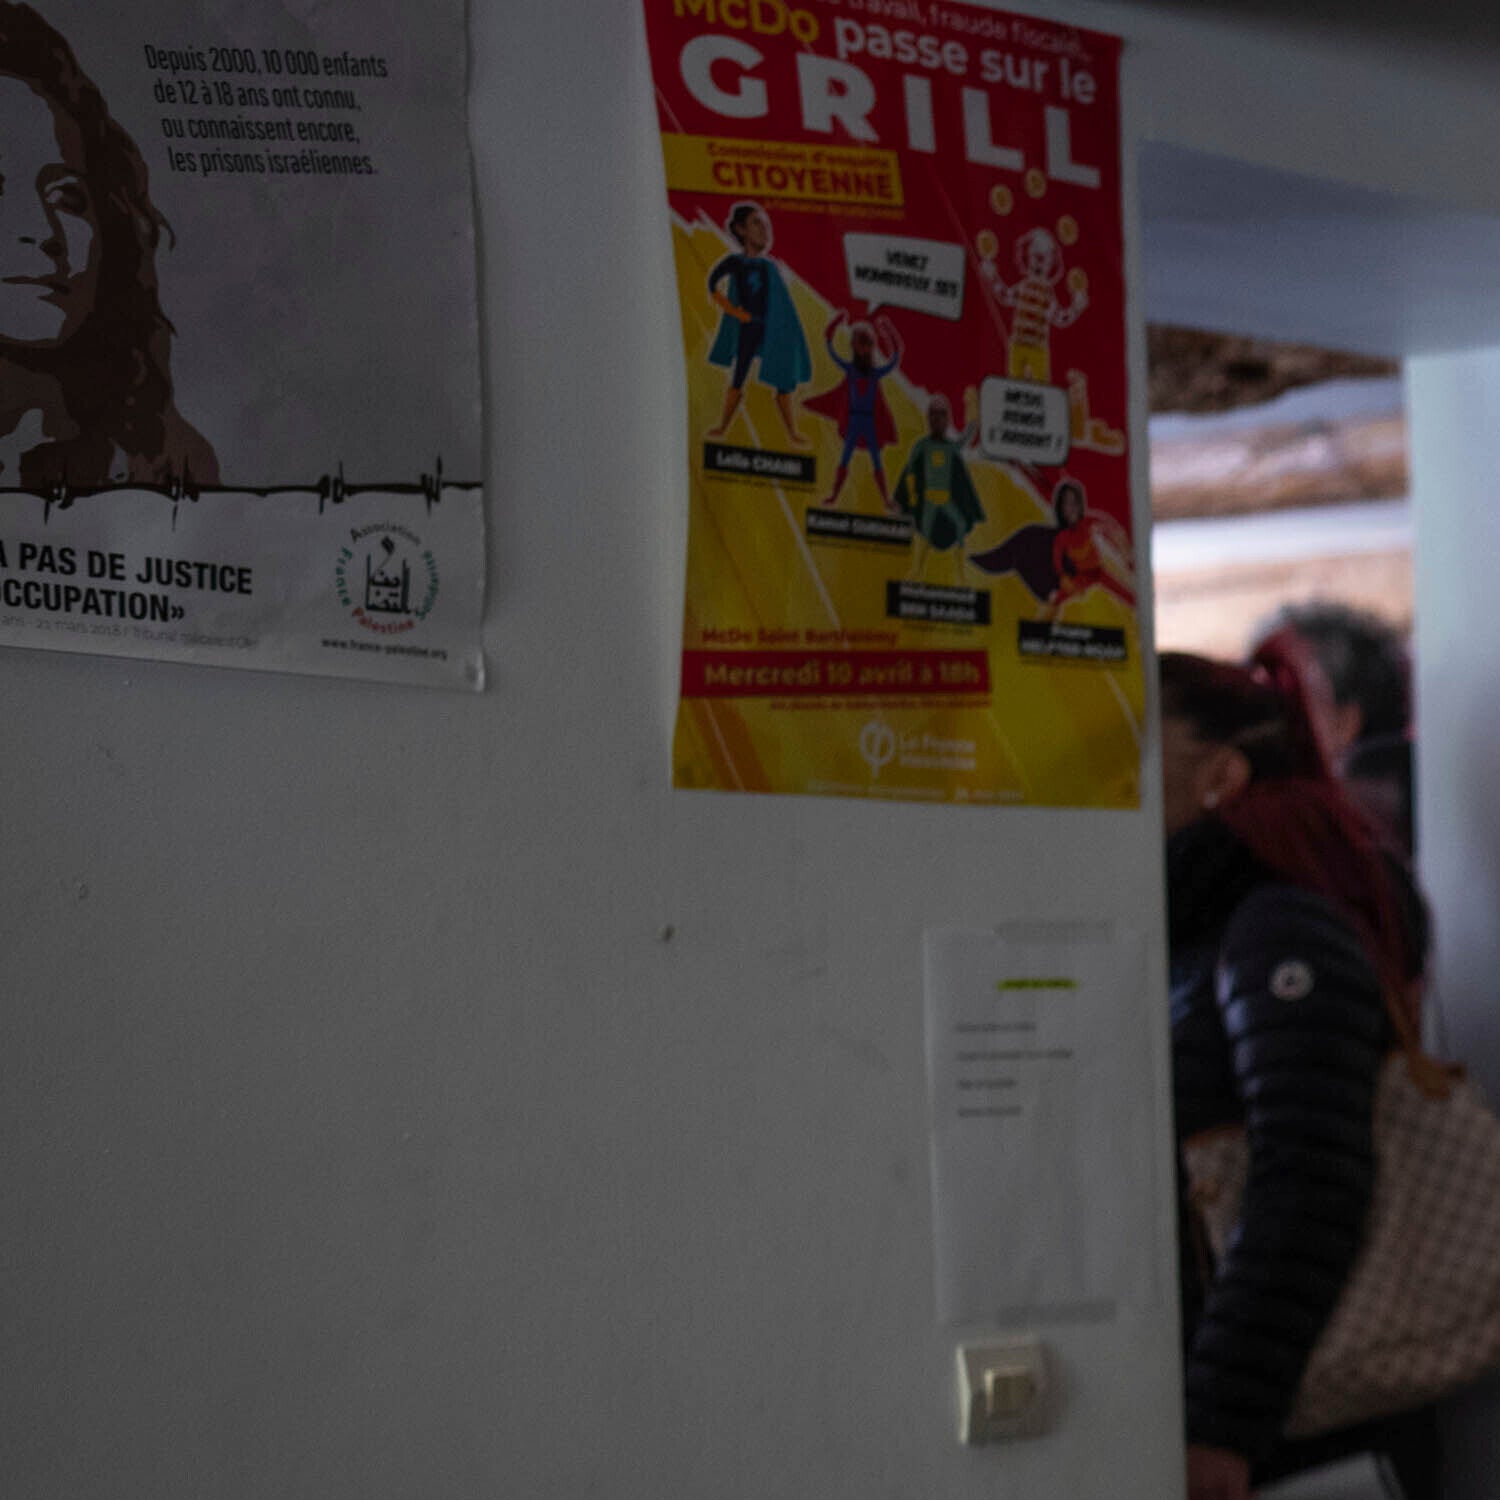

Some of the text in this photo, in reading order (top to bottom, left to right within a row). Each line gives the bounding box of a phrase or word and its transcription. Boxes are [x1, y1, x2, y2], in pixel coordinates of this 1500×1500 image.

[143, 44, 206, 74] Depuis
[321, 51, 389, 77] enfants
[673, 0, 1097, 104] McDo passe sur le
[153, 79, 362, 112] de 12 à 18 ans ont connu,
[679, 33, 1101, 190] GRILL
[161, 113, 361, 145] ou connaissent encore,
[168, 145, 198, 172] les
[199, 147, 266, 177] prisons
[711, 160, 893, 200] CITOYENNE
[19, 542, 78, 576] PAS
[87, 549, 128, 583] DE
[136, 555, 254, 596] JUSTICE
[704, 659, 822, 687] Mercredi
